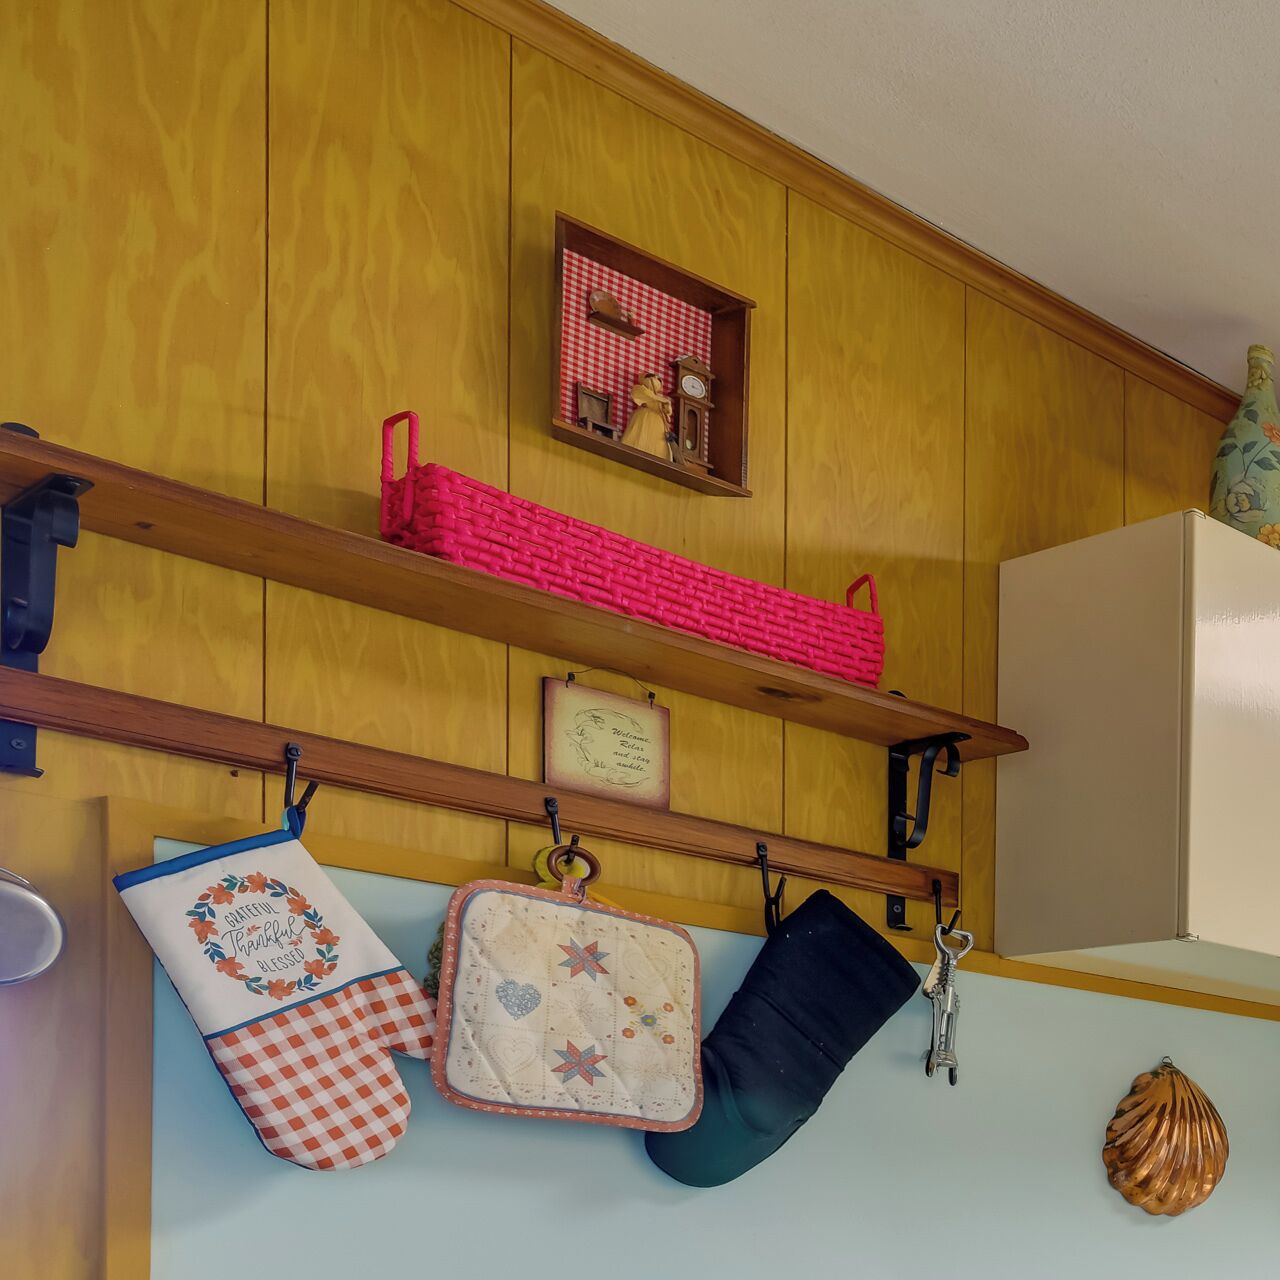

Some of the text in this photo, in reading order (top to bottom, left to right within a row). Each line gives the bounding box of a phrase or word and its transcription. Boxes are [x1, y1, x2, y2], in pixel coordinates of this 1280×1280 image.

[613, 750, 651, 764] and stay
[619, 740, 645, 752] Relax
[224, 902, 280, 928] GRATEFUL
[221, 916, 307, 957] Thankful
[257, 948, 305, 973] BLESSED
